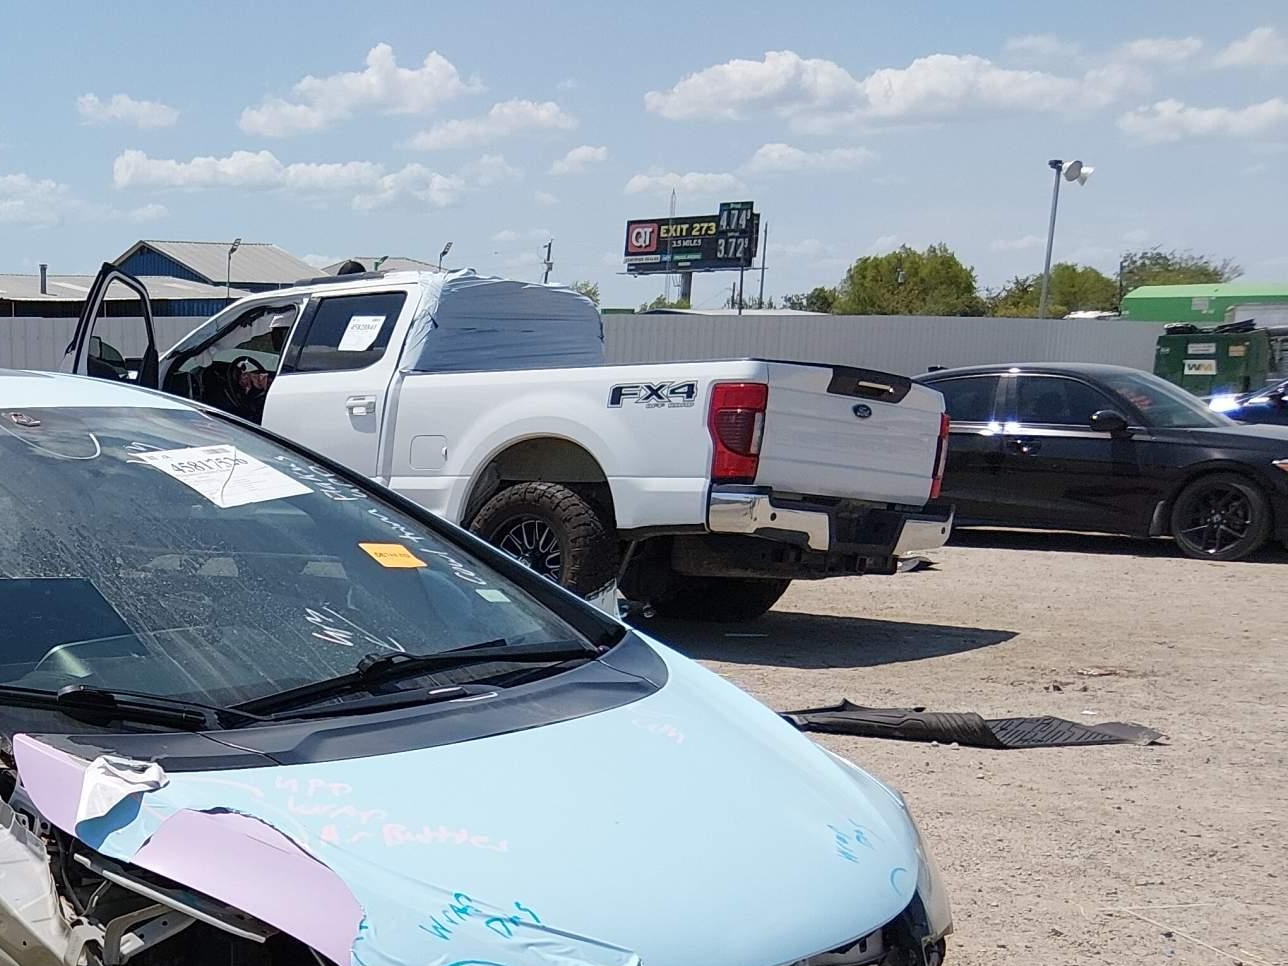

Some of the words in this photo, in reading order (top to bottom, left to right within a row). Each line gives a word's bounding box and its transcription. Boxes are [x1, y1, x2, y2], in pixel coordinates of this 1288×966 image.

[632, 228, 652, 247] QT
[660, 224, 689, 237] EXIT
[692, 222, 716, 236] 273
[607, 380, 698, 408] FX4
